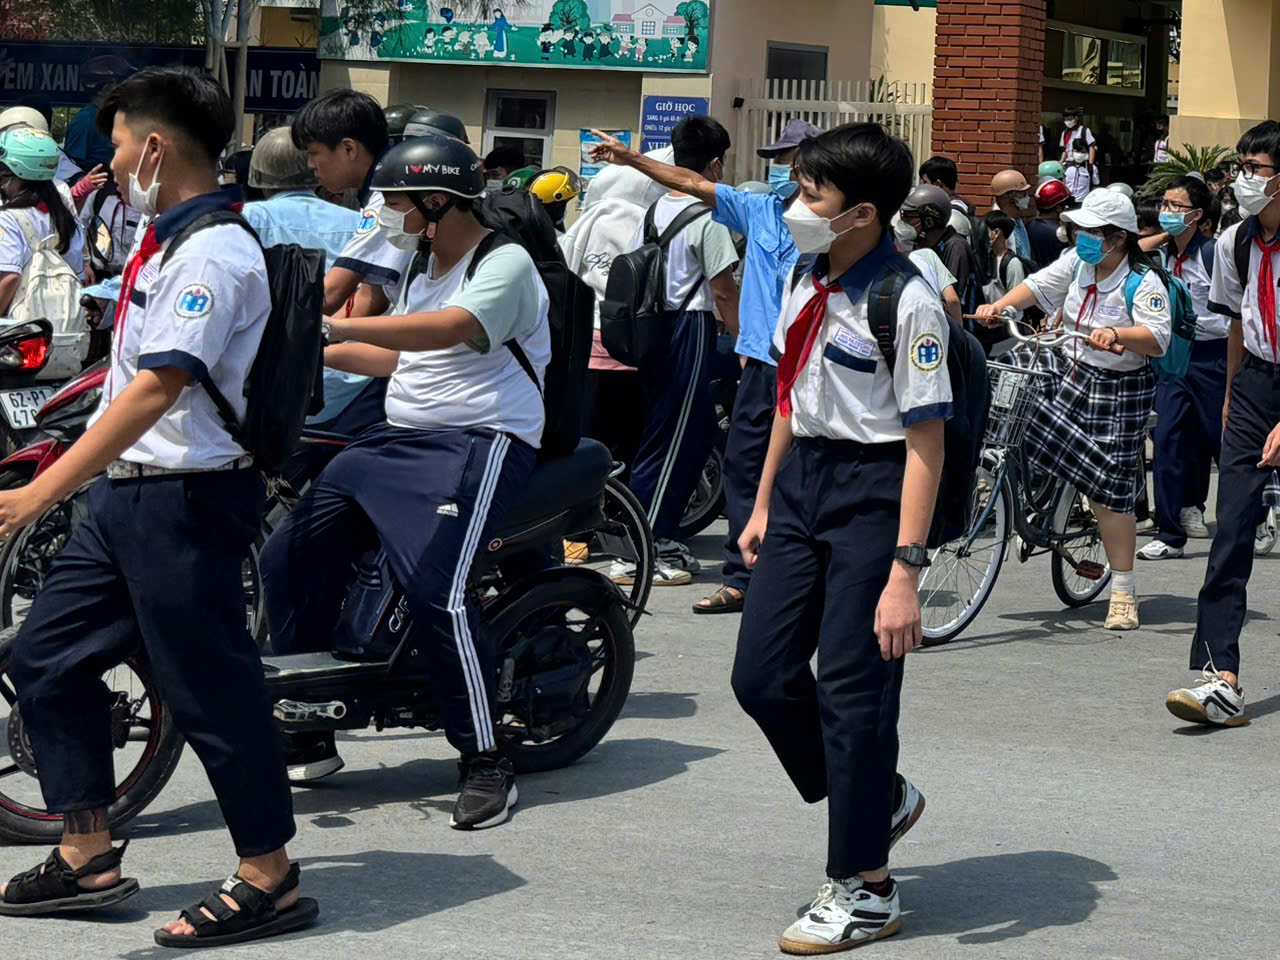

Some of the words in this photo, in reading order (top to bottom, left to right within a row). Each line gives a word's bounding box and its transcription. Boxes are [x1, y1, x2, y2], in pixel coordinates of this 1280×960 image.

[655, 100, 673, 111] GIỜ
[674, 103, 696, 114] HỌC
[422, 163, 440, 174] MY
[441, 164, 461, 176] BIKE
